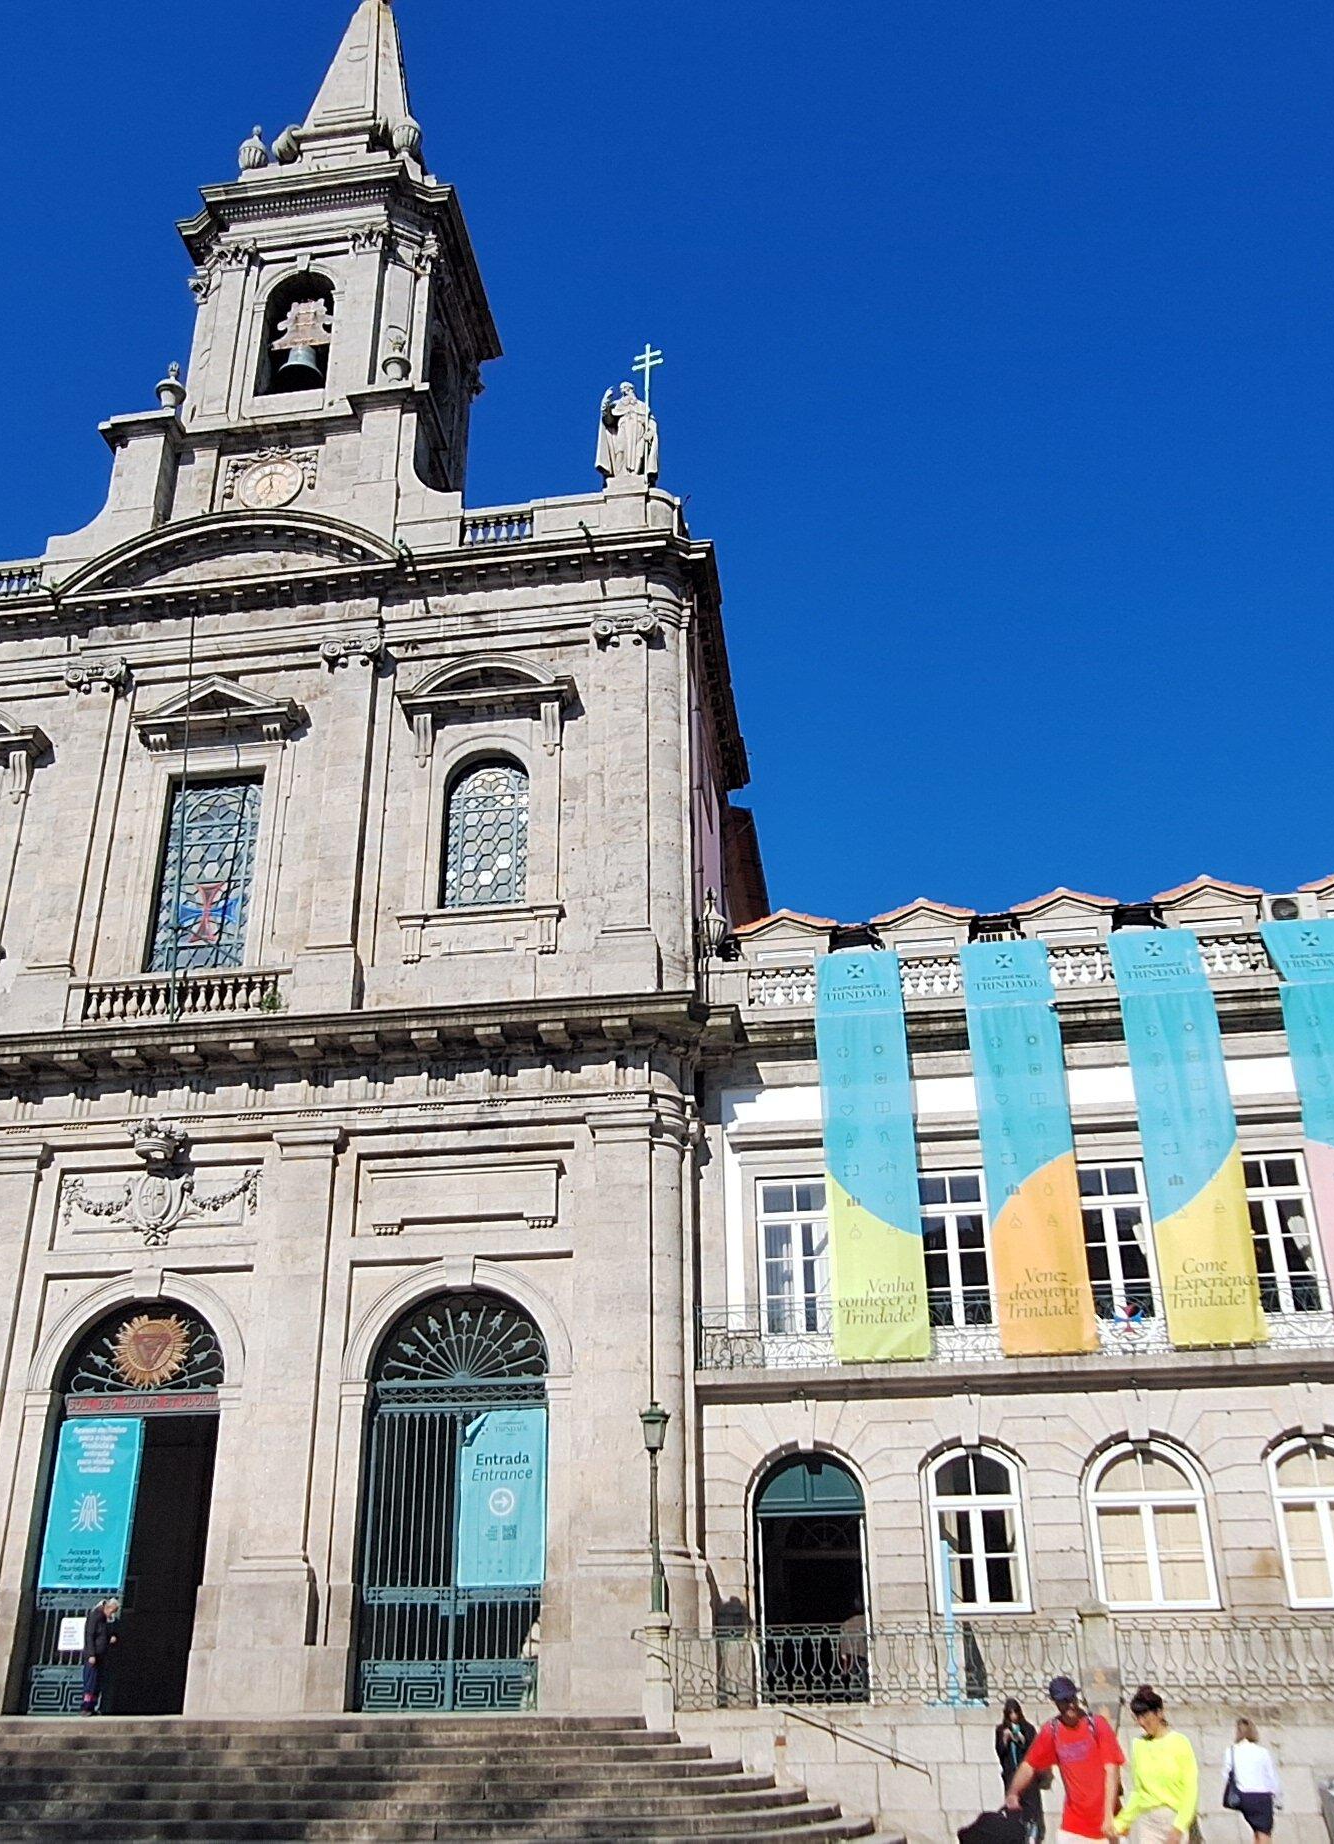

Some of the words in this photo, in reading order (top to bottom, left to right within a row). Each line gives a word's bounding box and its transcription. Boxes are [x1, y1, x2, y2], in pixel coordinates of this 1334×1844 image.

[973, 979, 1044, 991] TRINDADE
[823, 988, 891, 1001] TRINDADE
[1182, 1257, 1228, 1275] Come
[869, 1275, 915, 1294] Venha
[1024, 1267, 1068, 1284] Venez
[1173, 1271, 1257, 1296] Experience
[838, 1289, 905, 1309] conhecer
[908, 1294, 917, 1305] a
[1168, 1287, 1247, 1310] Trindade!
[842, 1305, 916, 1325] Trindade!
[1005, 1298, 1080, 1319] Trindade!
[476, 1450, 530, 1466] Entrada
[472, 1468, 533, 1481] Entrance
